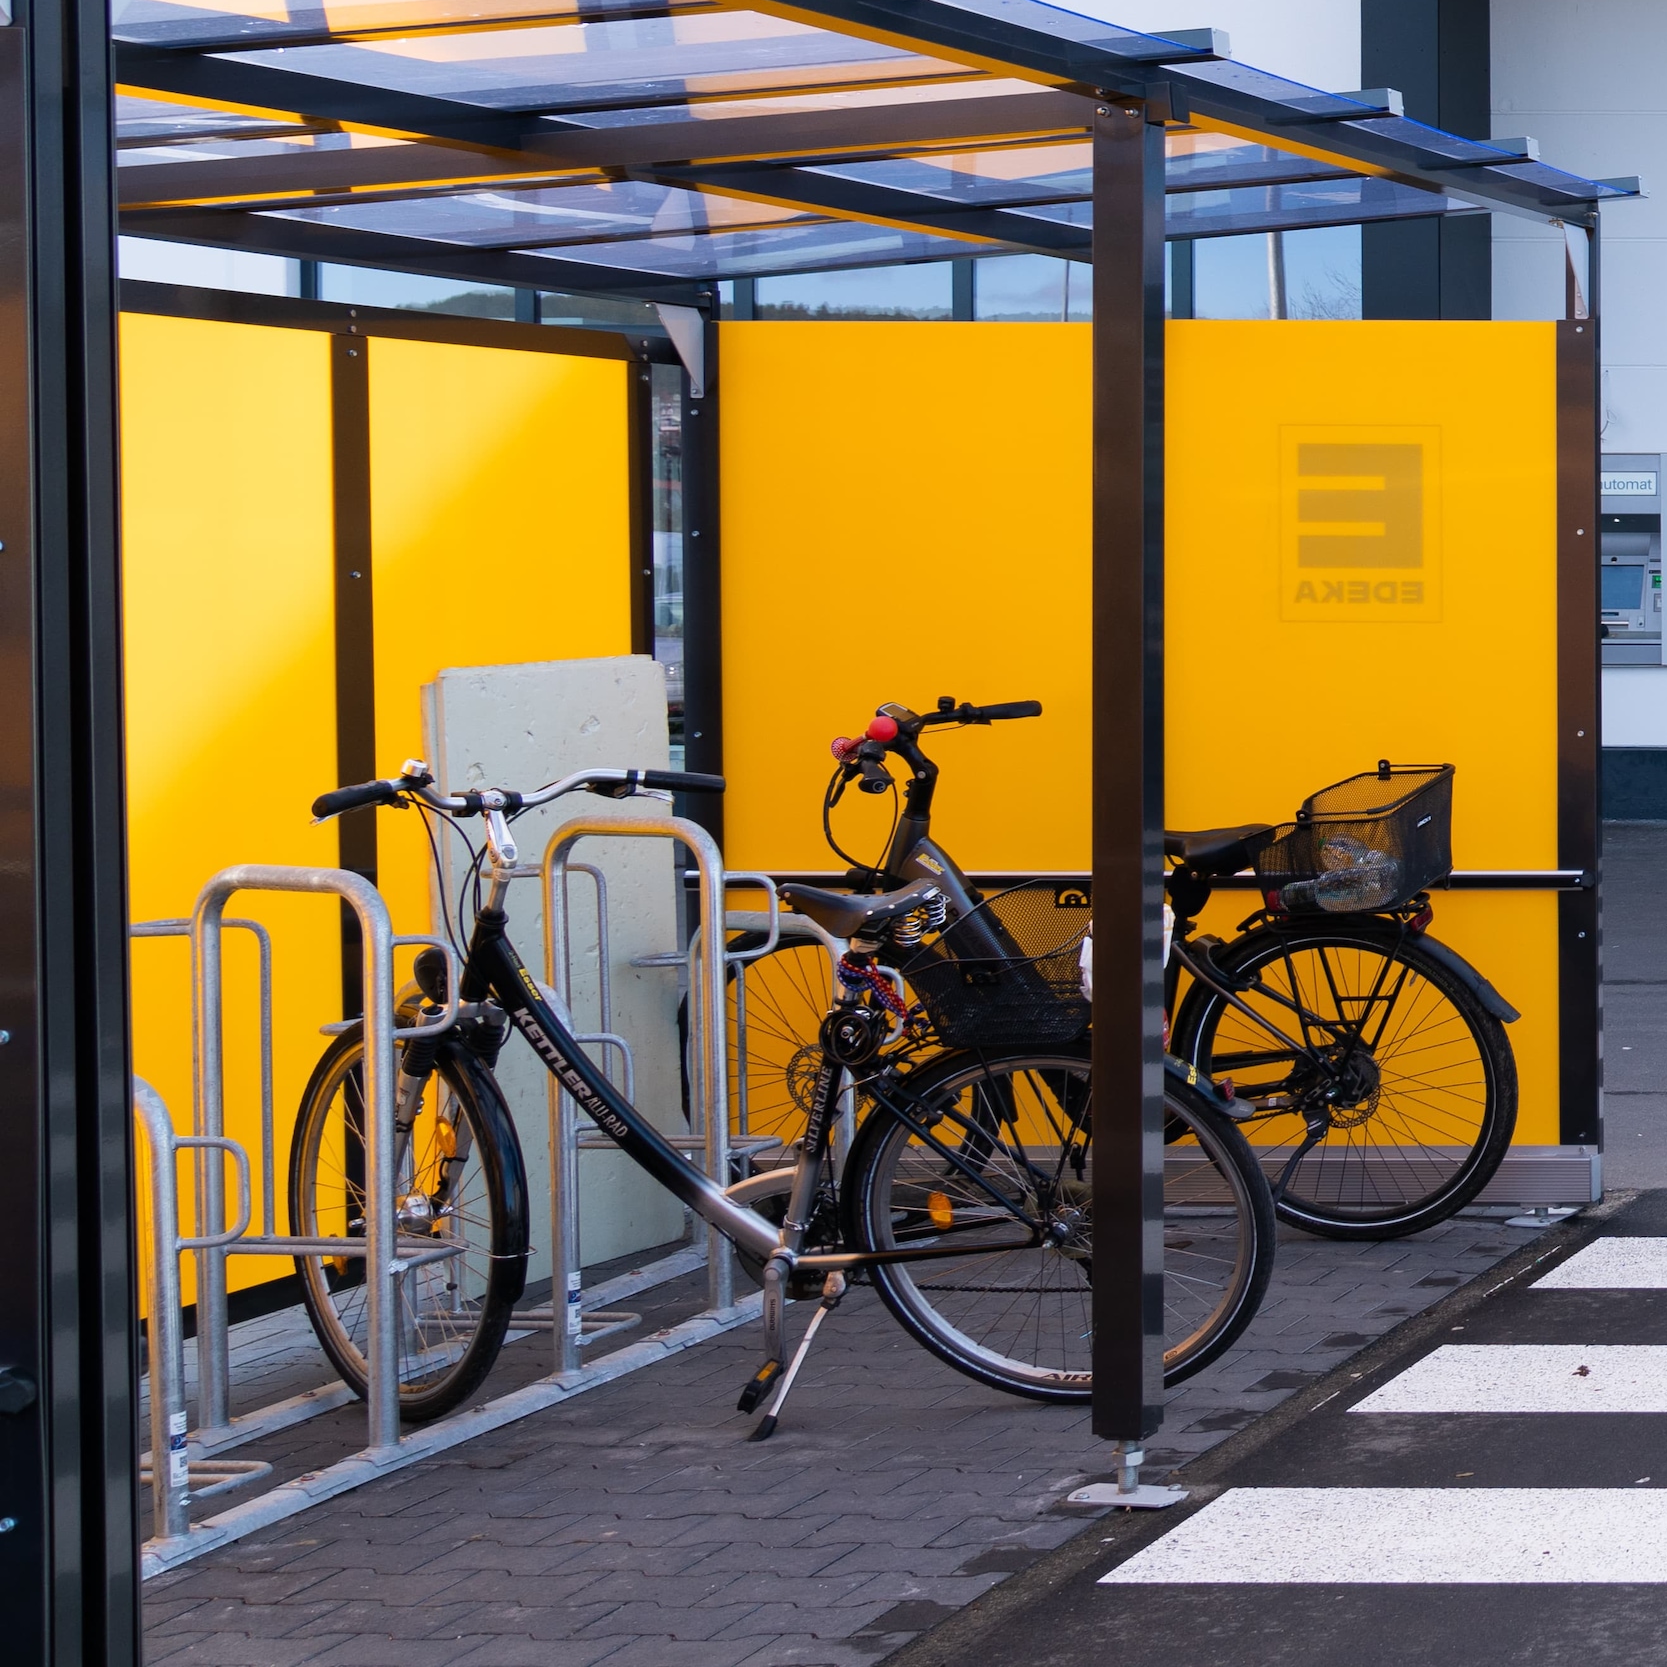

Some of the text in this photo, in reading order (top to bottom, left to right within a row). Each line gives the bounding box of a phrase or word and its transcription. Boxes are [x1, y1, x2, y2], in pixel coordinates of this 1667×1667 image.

[519, 968, 542, 1001] Esser
[513, 1007, 628, 1137] KETTLER ALU-RAD
[806, 1065, 832, 1152] SILVERLINE
[1042, 1373, 1093, 1381] AIR
